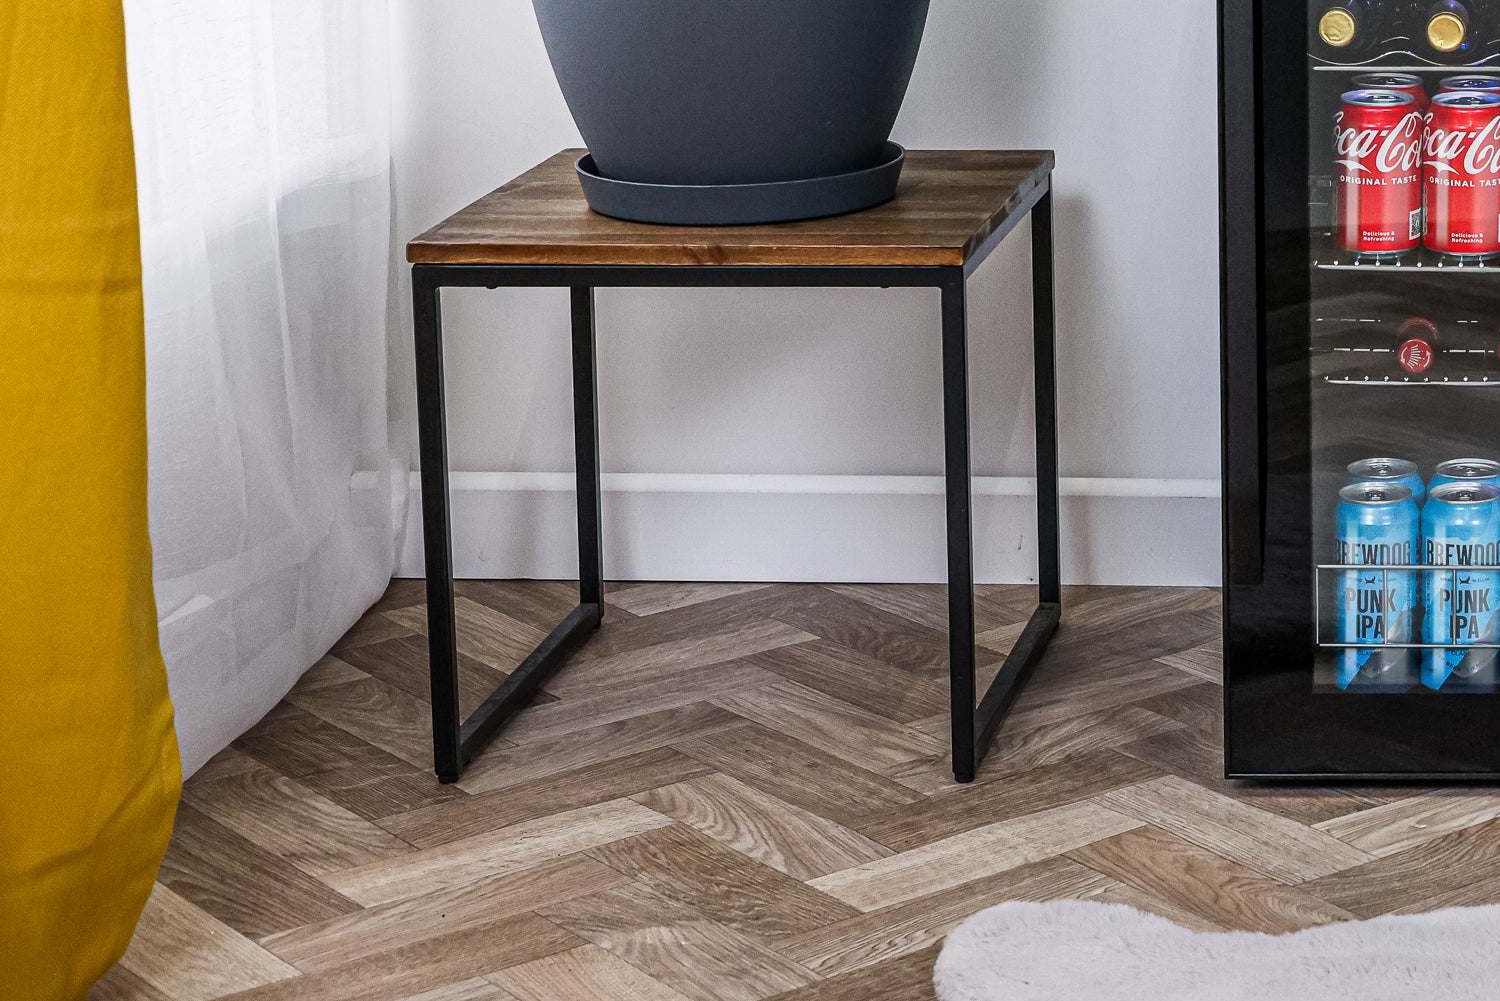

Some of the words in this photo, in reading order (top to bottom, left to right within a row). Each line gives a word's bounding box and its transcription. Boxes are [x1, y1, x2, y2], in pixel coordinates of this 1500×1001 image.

[1340, 174, 1388, 186] ORIGINAL
[1391, 174, 1417, 185] TASTE
[1429, 176, 1476, 188] ORIGINAL
[1345, 587, 1397, 614] PUNK
[1439, 587, 1491, 614] PUNK
[1356, 614, 1385, 639] IPA
[1449, 614, 1480, 640] IPA
